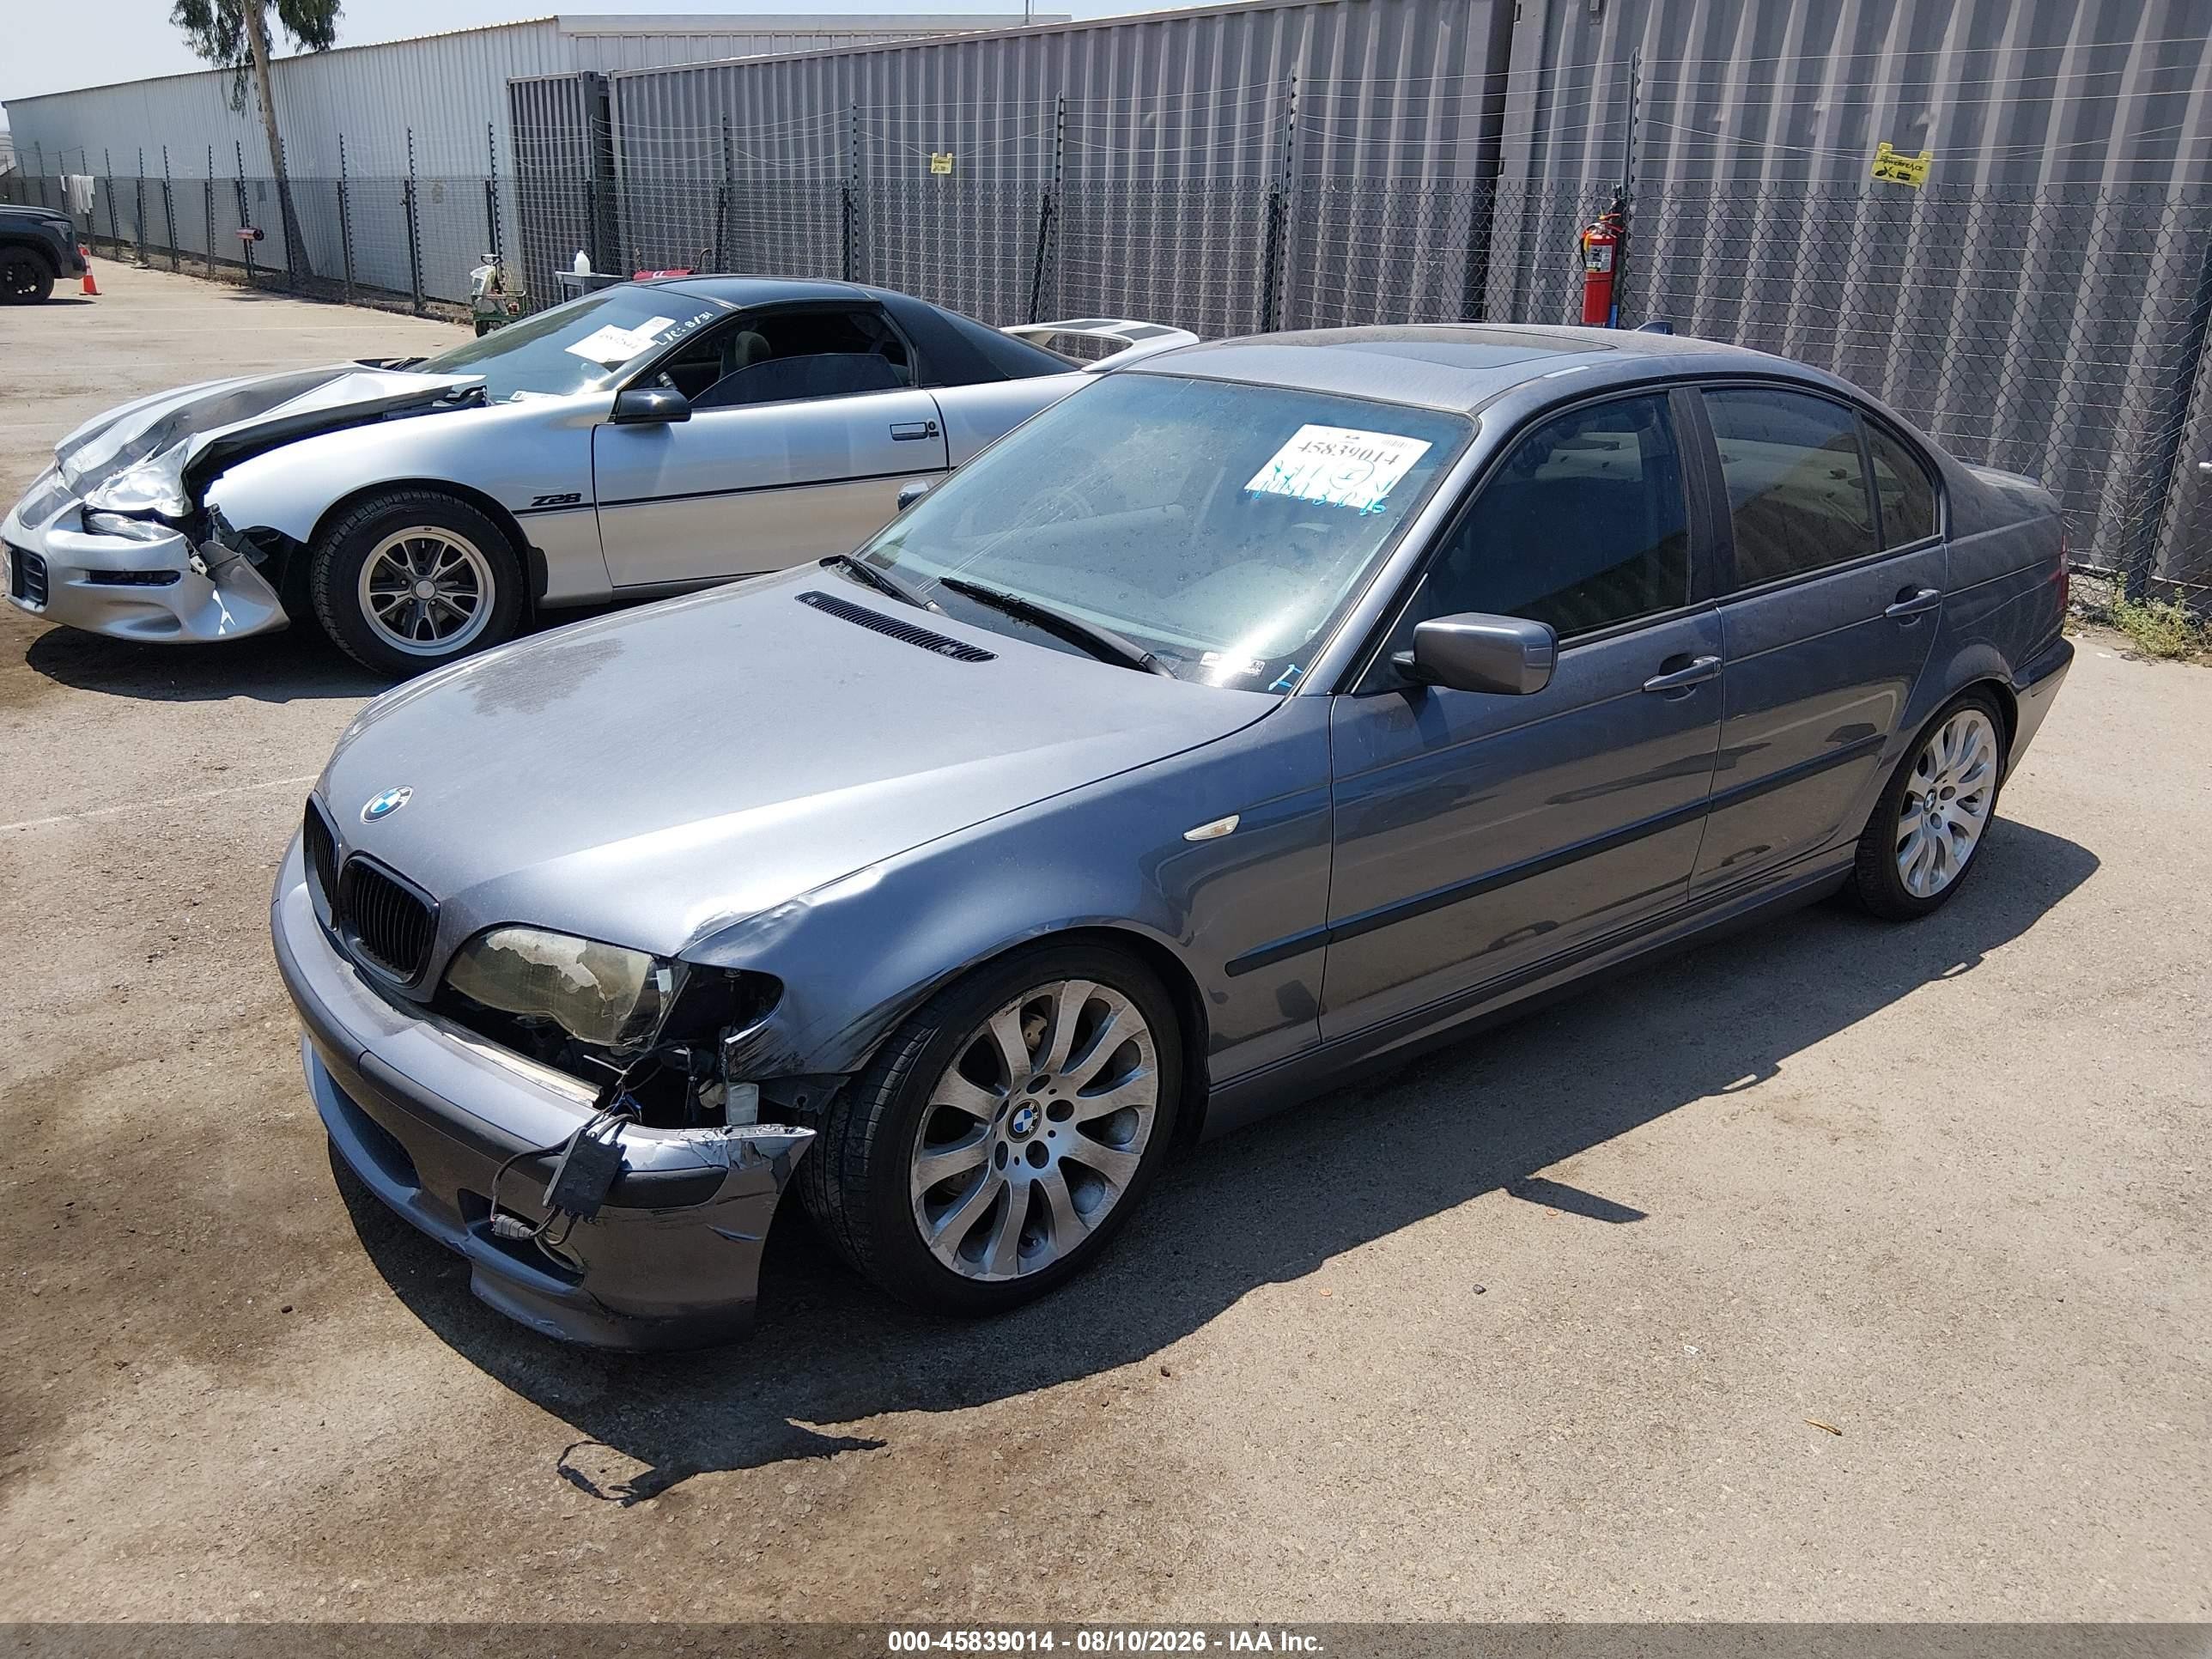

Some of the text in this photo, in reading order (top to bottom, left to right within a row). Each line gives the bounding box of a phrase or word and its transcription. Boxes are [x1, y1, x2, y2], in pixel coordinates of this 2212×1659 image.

[684, 312, 714, 328] 8/31
[1297, 441, 1401, 465] 45839014
[531, 492, 581, 507] Z28
